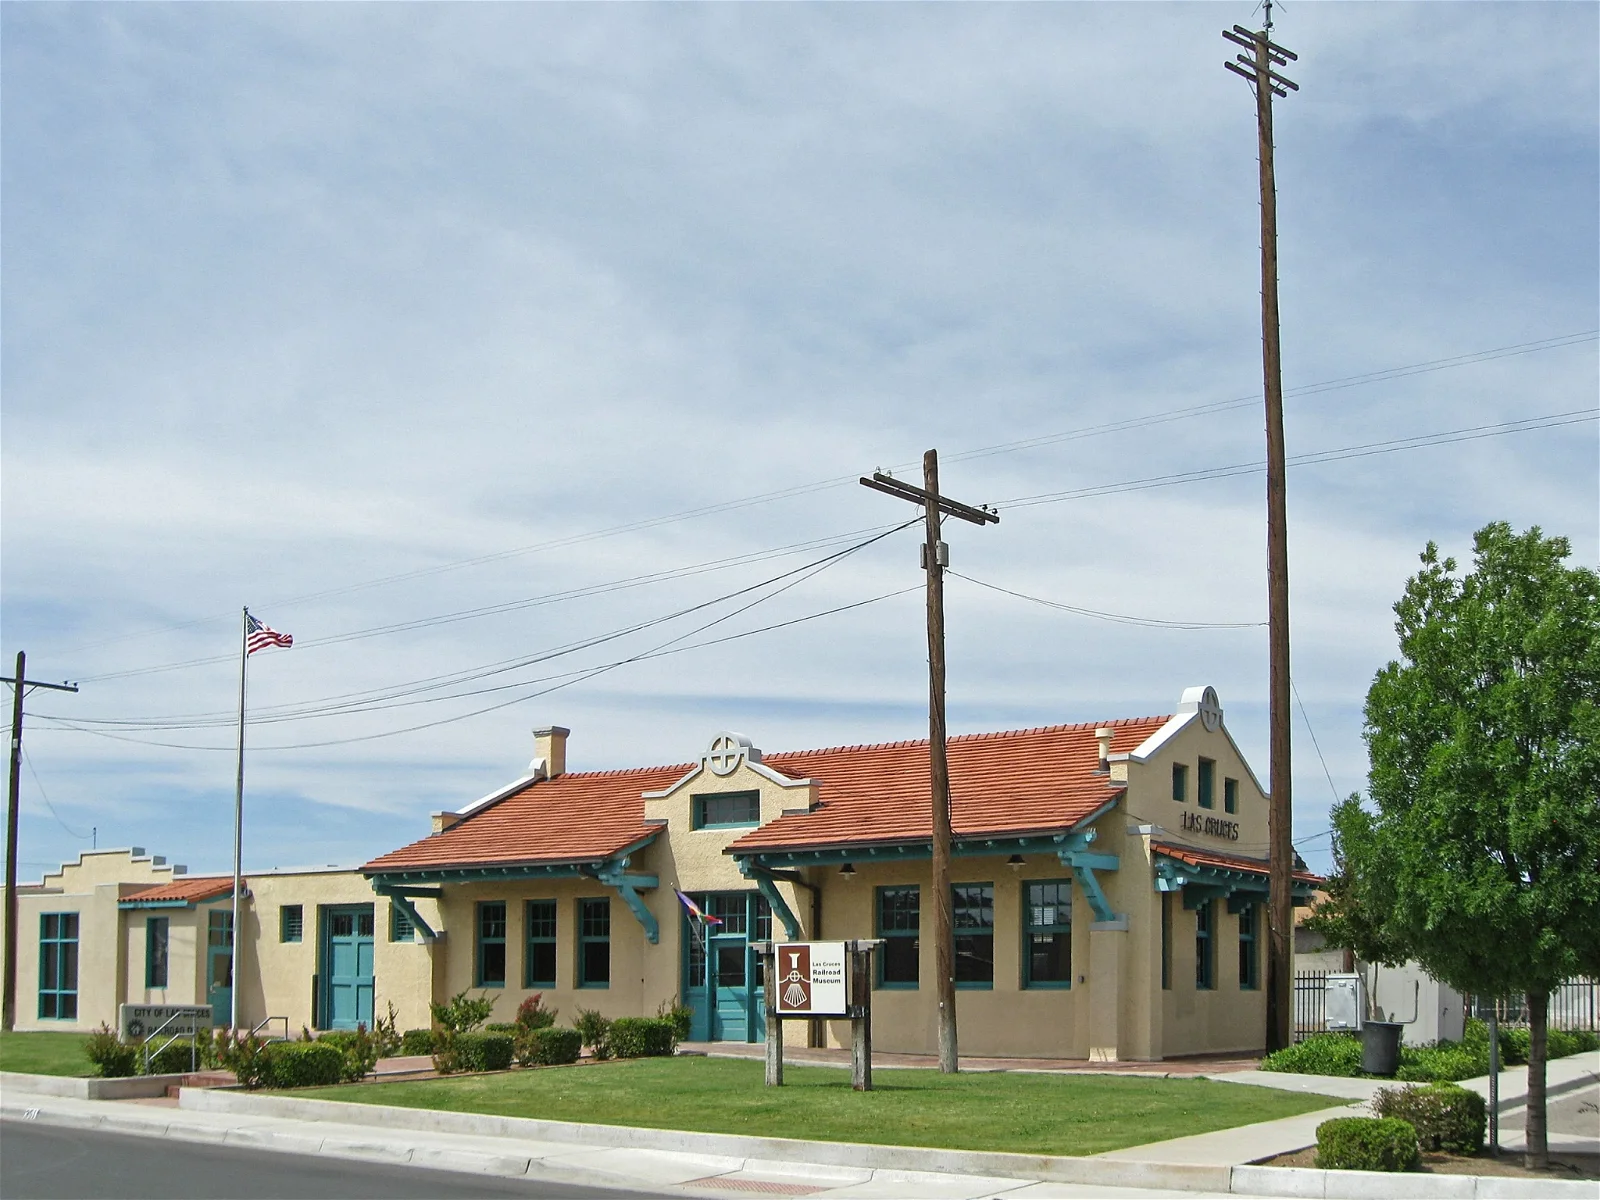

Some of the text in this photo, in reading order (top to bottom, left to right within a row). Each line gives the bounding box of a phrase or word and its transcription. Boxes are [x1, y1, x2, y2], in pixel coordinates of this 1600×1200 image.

[1181, 811, 1239, 840] LAS CRUCES
[134, 1008, 151, 1018] CITY
[154, 1008, 163, 1018] OF
[166, 1008, 180, 1018] LAS
[148, 1026, 185, 1036] RAROAD
